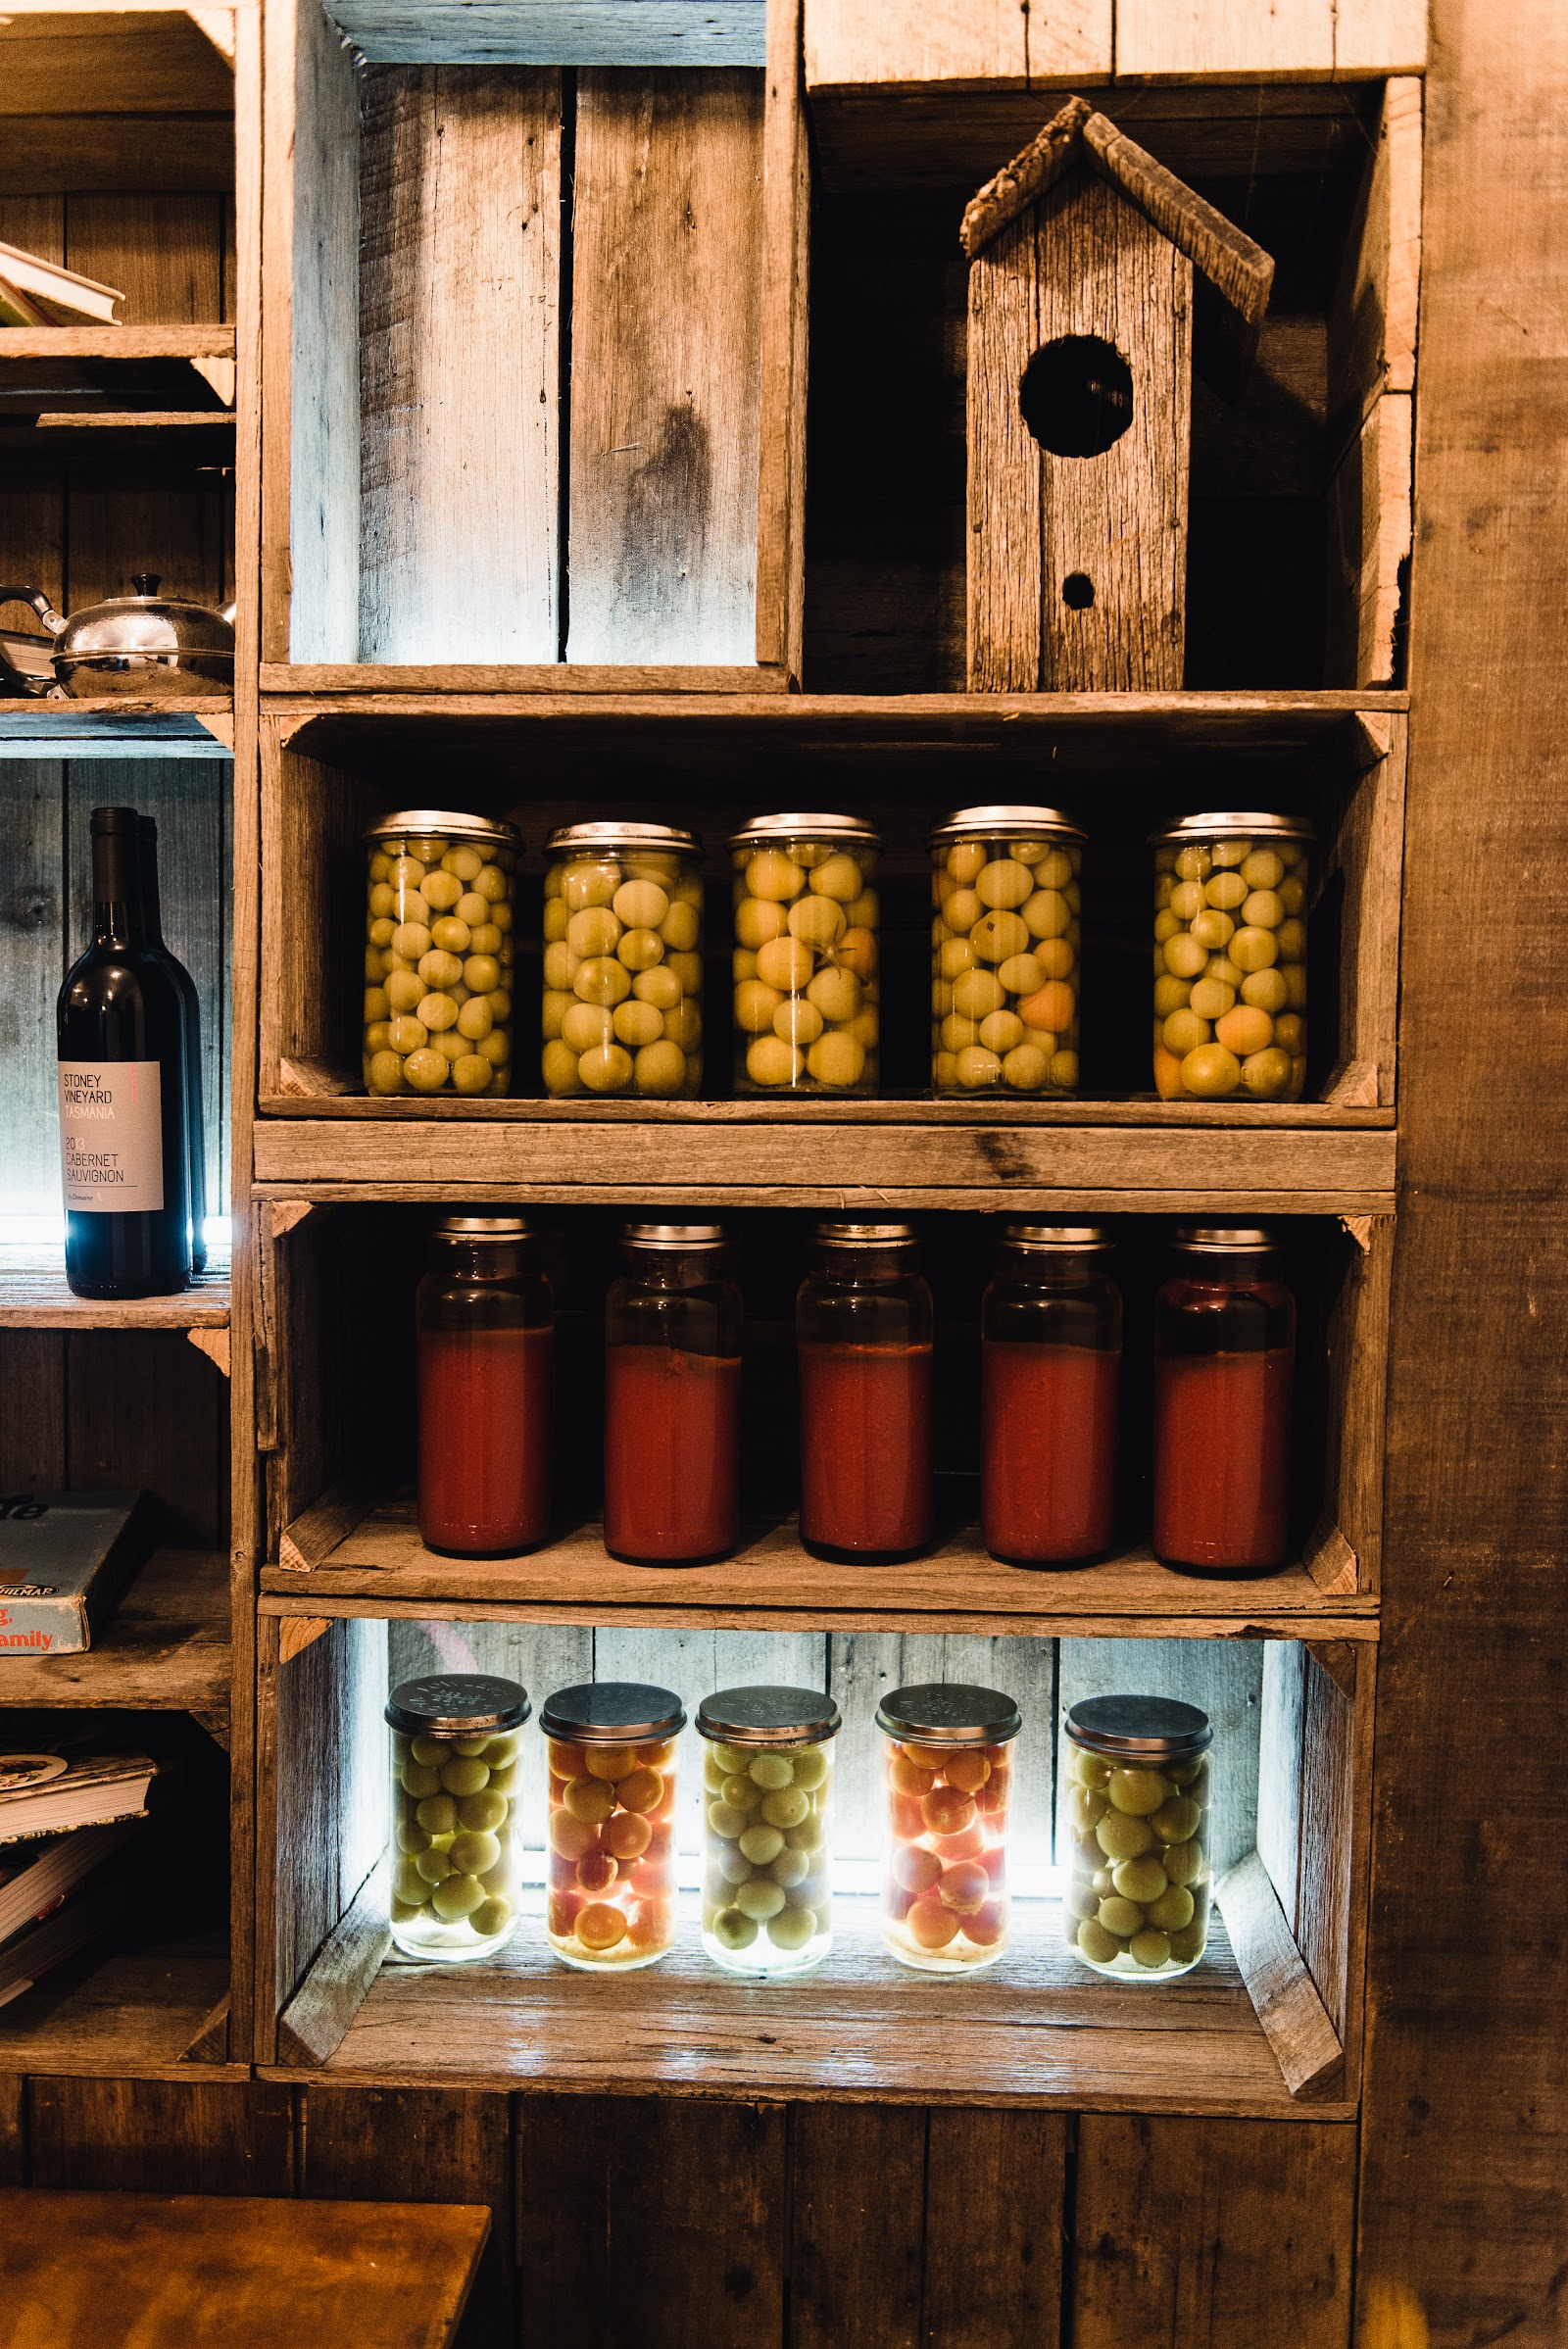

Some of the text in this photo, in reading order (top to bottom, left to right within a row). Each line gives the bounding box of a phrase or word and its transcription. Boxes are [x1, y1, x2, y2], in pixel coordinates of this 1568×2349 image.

[64, 1074, 101, 1088] STONEY
[64, 1090, 112, 1103] VINEYARD
[65, 1105, 116, 1119] TASMANIA
[66, 1137, 86, 1150] 2013
[67, 1152, 119, 1167] CABERNET
[67, 1168, 124, 1183] SAUVIGNON
[73, 1193, 93, 1201] Domaine
